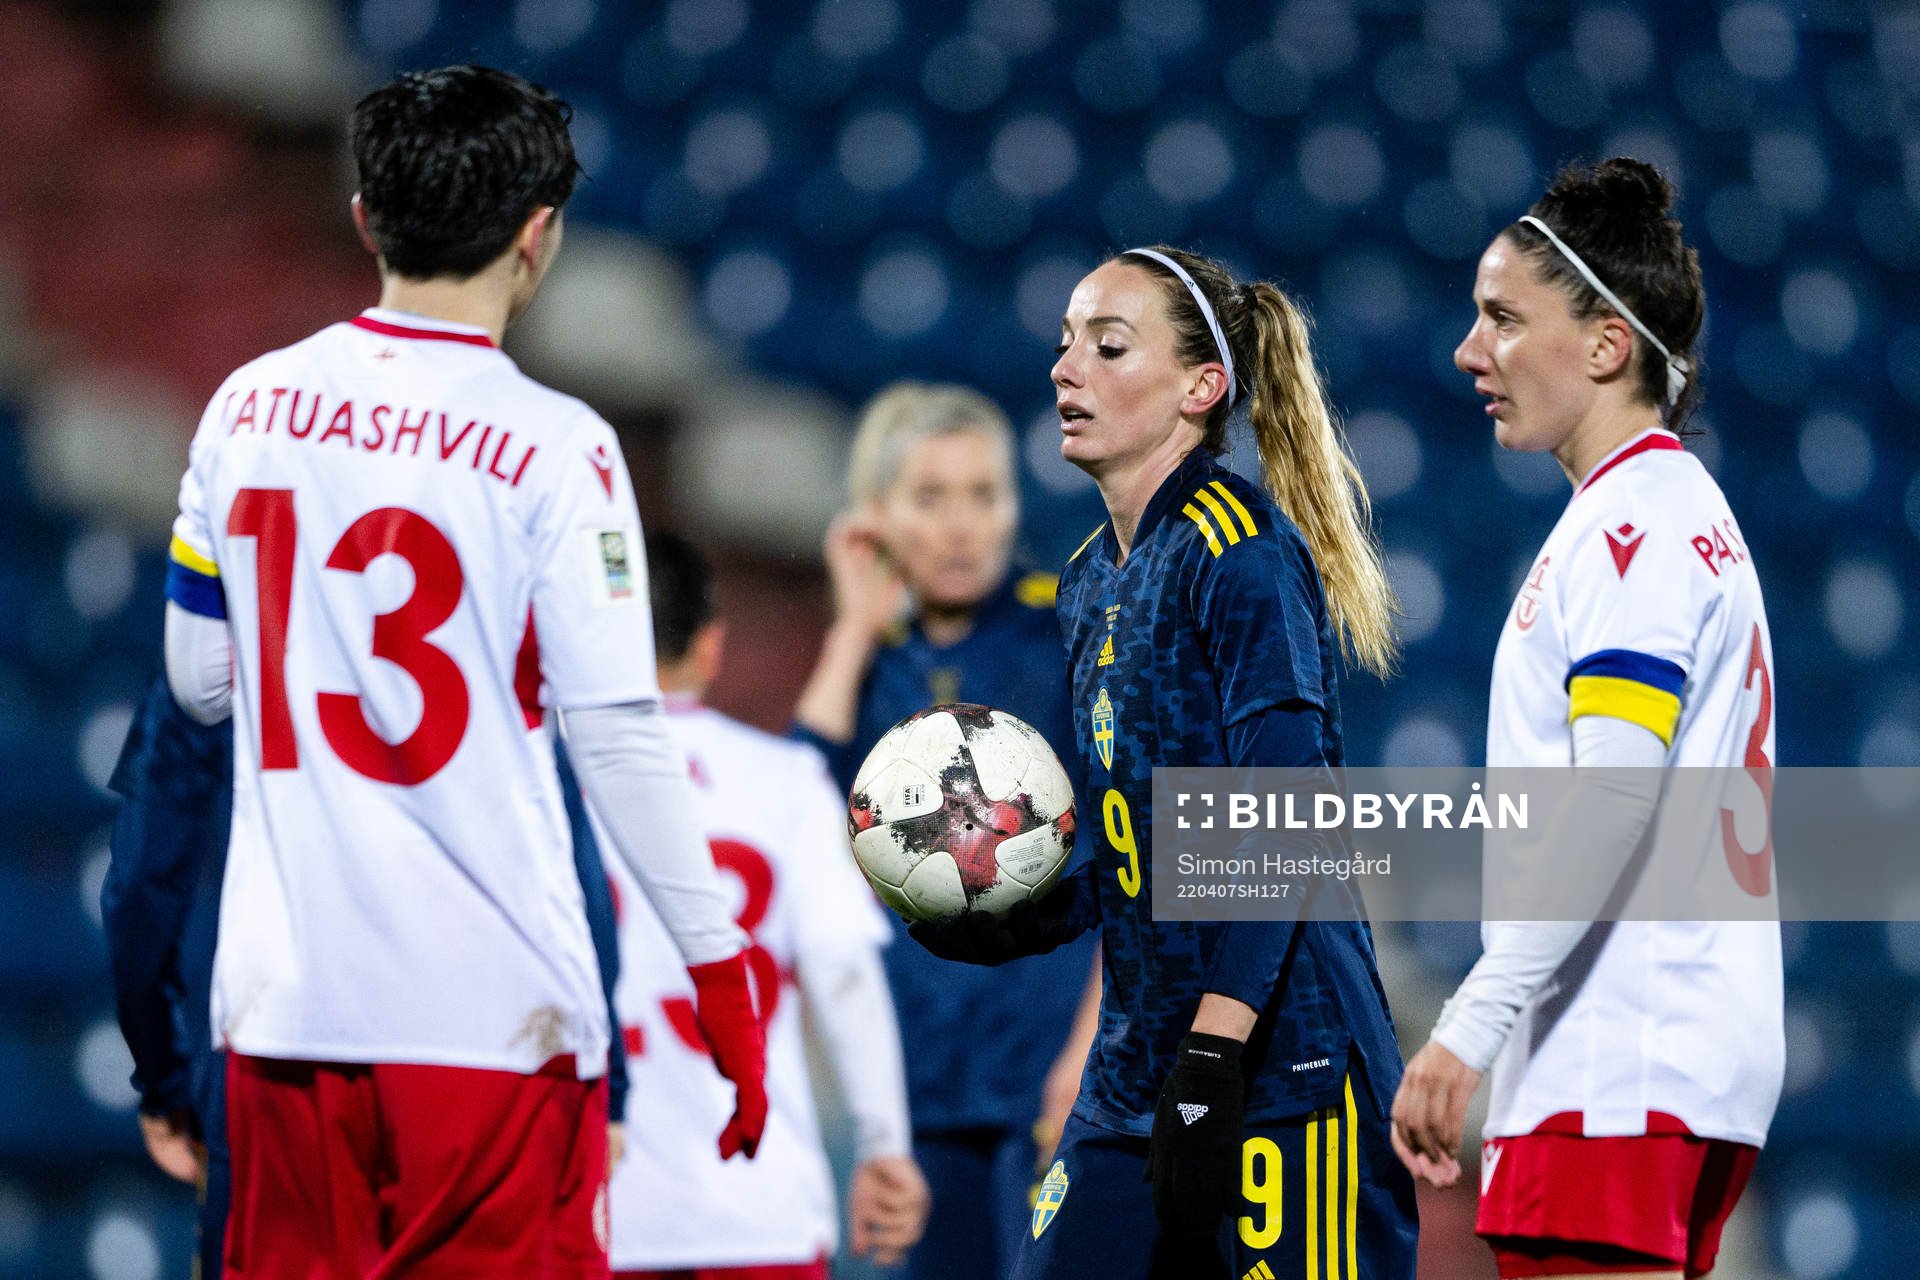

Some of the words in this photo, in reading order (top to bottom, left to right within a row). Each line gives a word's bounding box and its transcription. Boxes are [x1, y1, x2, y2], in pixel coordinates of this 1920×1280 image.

[227, 488, 471, 788] 13
[1103, 788, 1141, 898] 9
[1292, 1058, 1330, 1073] PRIMEBLUE
[1237, 1136, 1283, 1249] 9
